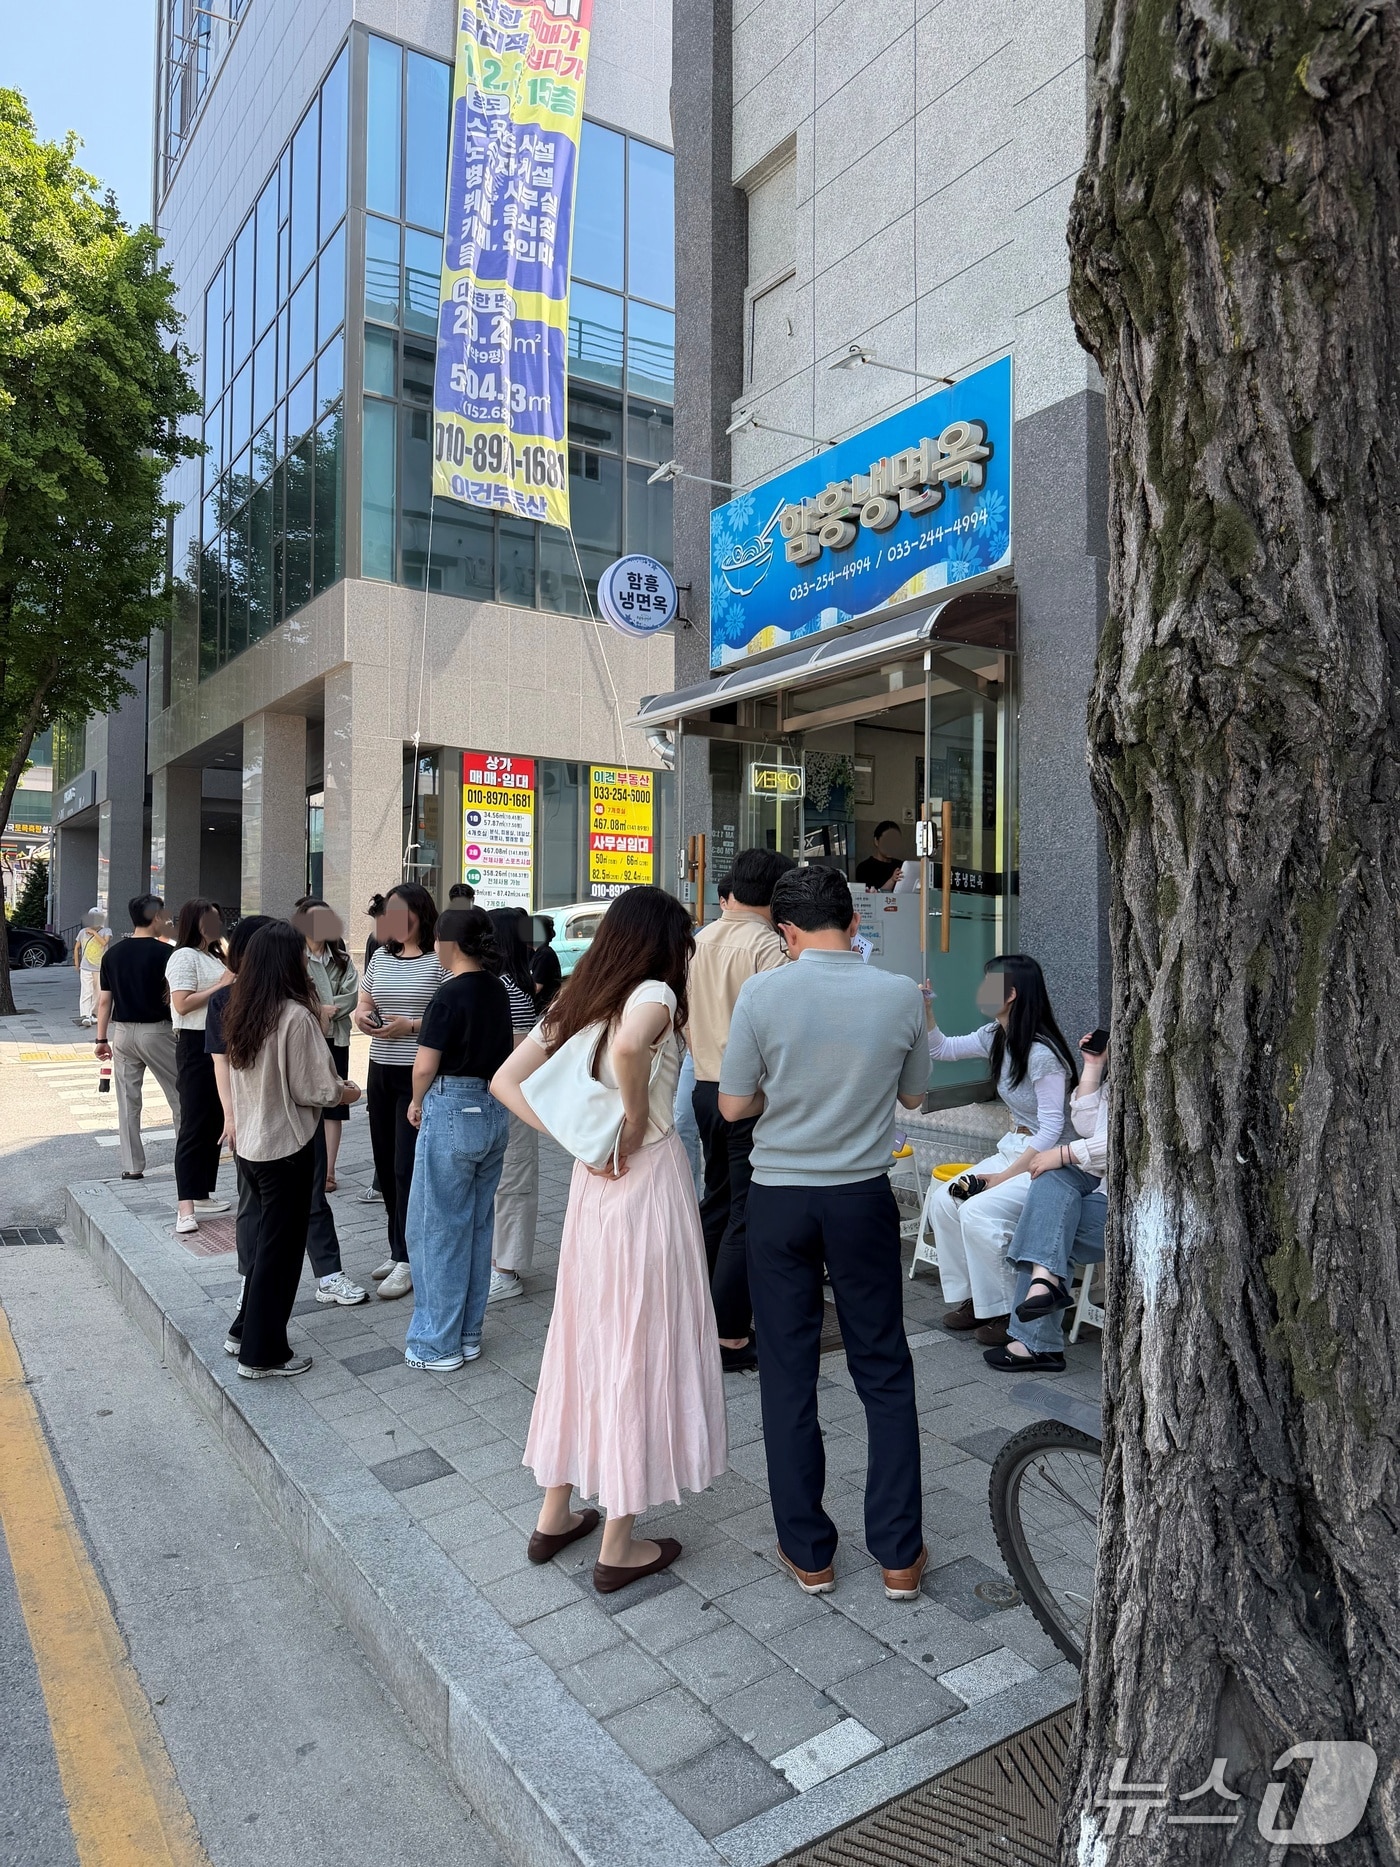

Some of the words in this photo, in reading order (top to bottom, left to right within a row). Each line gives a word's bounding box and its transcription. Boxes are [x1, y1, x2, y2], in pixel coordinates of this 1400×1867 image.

[519, 134, 555, 163] 시설
[458, 282, 491, 309] 다한
[780, 420, 990, 563] 함흥냉면옥
[790, 555, 871, 601] 033-254-4994
[887, 508, 989, 562] 033-244-4994
[627, 572, 659, 593] 함흥
[620, 591, 668, 614] 냉면옥
[486, 756, 512, 771] 상가
[467, 789, 531, 808] 010-8970-1681
[594, 786, 650, 803] 033-254-6000
